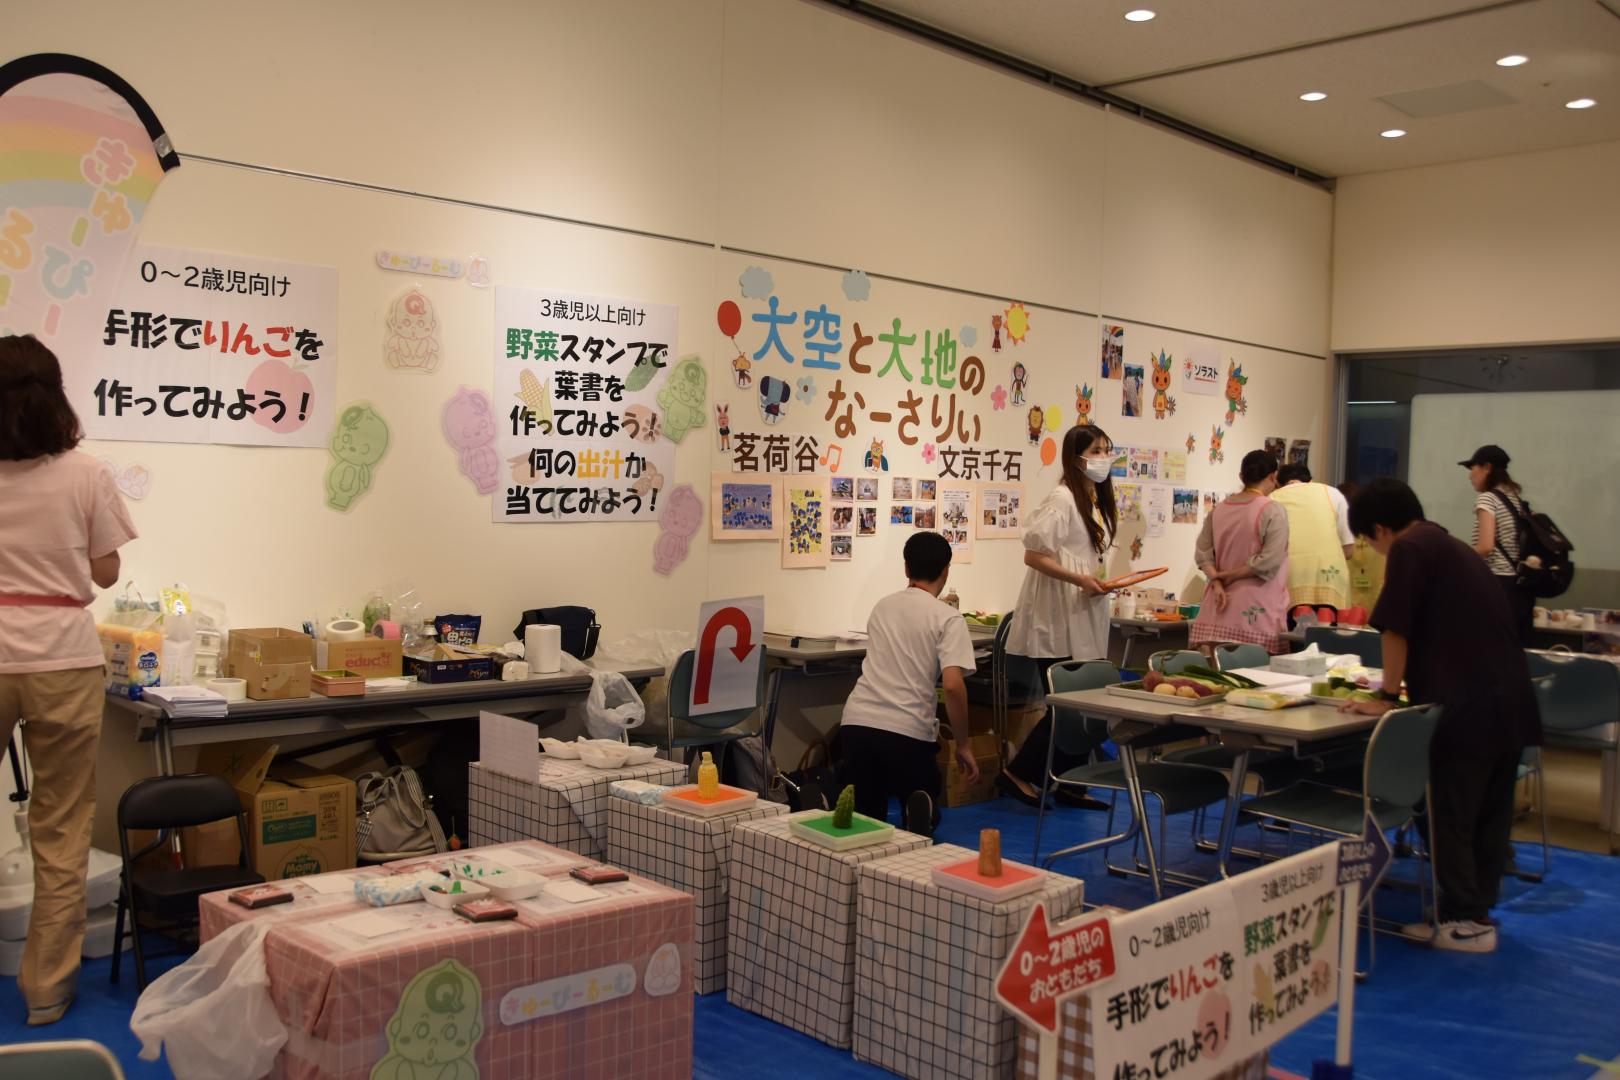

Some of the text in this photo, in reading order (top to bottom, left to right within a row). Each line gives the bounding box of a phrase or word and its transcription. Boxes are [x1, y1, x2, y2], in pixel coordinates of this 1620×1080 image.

[540, 298, 646, 327] 3歳児以上向け
[103, 309, 324, 361] 手形でりんごを
[506, 327, 669, 369] 野菜スタンプで
[751, 296, 985, 396] 大空と大地の
[555, 369, 626, 402] 葉書を
[1194, 364, 1219, 380] ソラスト
[528, 447, 647, 480] 何の出汁か
[733, 432, 820, 473] 茗荷谷
[938, 445, 1023, 482] 文京千石
[1261, 863, 1325, 903] 3歳児以上向け
[1244, 890, 1336, 957] 野菜スタンプで
[1029, 957, 1102, 1004] おともだち
[1106, 951, 1234, 1031] 手形でりんごを
